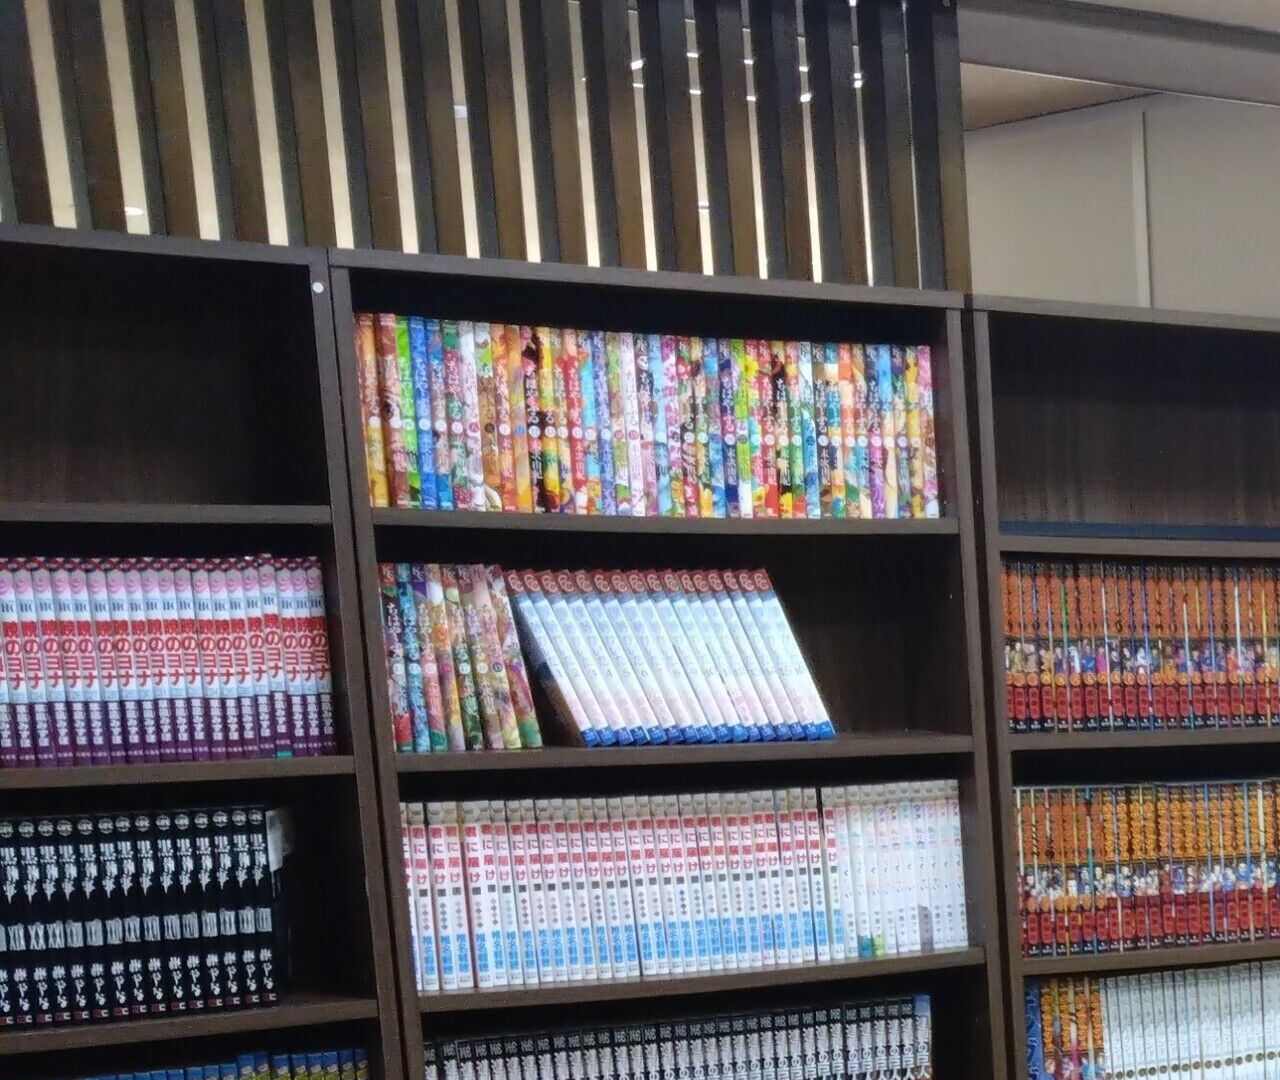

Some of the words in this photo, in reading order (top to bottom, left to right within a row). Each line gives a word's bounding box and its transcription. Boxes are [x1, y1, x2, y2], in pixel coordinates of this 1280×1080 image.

[431, 827, 445, 884] 君に届け
[465, 826, 480, 883] 君に届け
[480, 824, 495, 880] 君に届け
[641, 820, 656, 875] 君に届け
[684, 818, 699, 871] 君に届け
[807, 811, 821, 864] 君に届け
[825, 809, 837, 862] 君に届け
[901, 1018, 915, 1080] 進撃の巨人
[916, 1017, 931, 1079] 進撃の巨人
